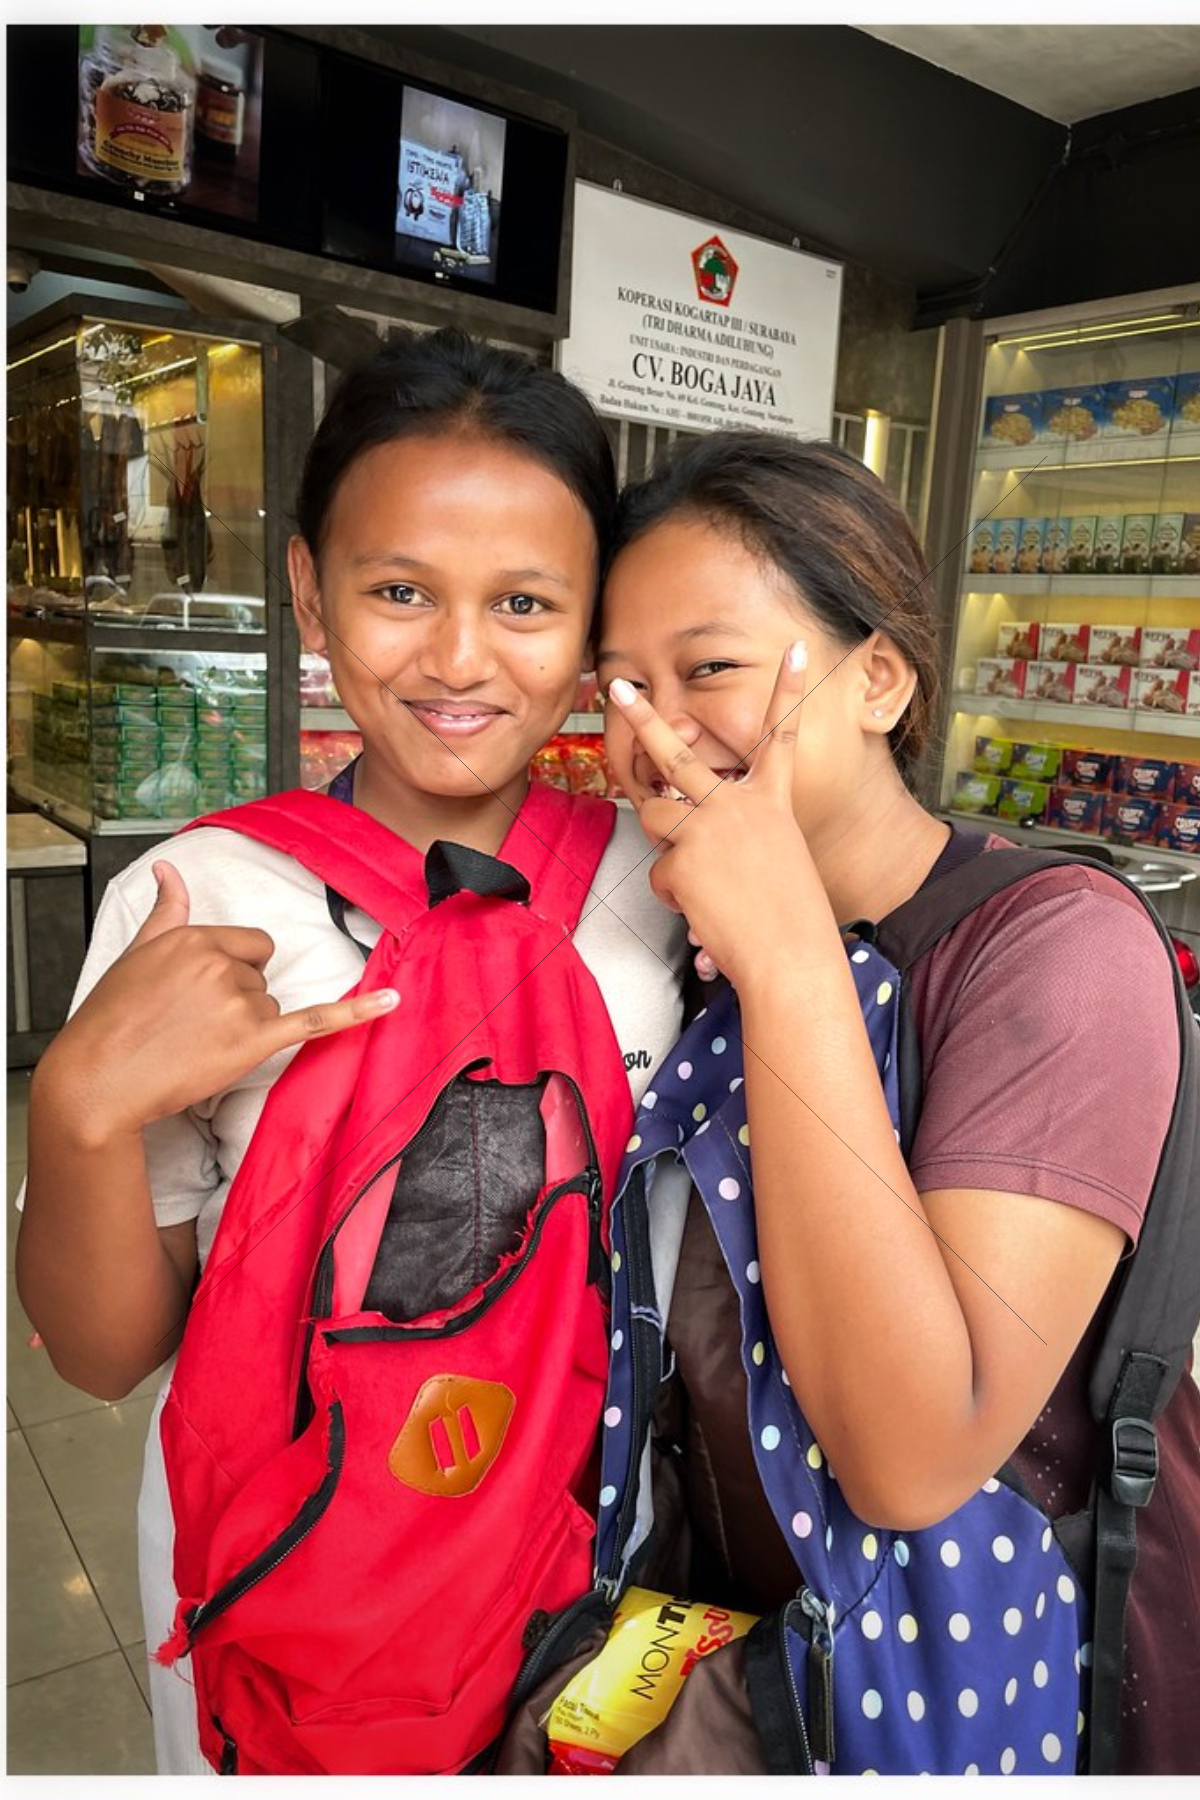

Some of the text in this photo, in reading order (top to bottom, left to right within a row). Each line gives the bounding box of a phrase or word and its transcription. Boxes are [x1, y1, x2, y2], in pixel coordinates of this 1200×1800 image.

[618, 287, 672, 313] KOPERASI
[674, 302, 730, 328] KOGARTAP
[748, 322, 797, 345] SURABAYA
[642, 314, 665, 331] (TRI
[666, 320, 713, 343] DHARMA
[629, 334, 649, 347] UNIT
[633, 353, 776, 407] CV. BOGA JAYA
